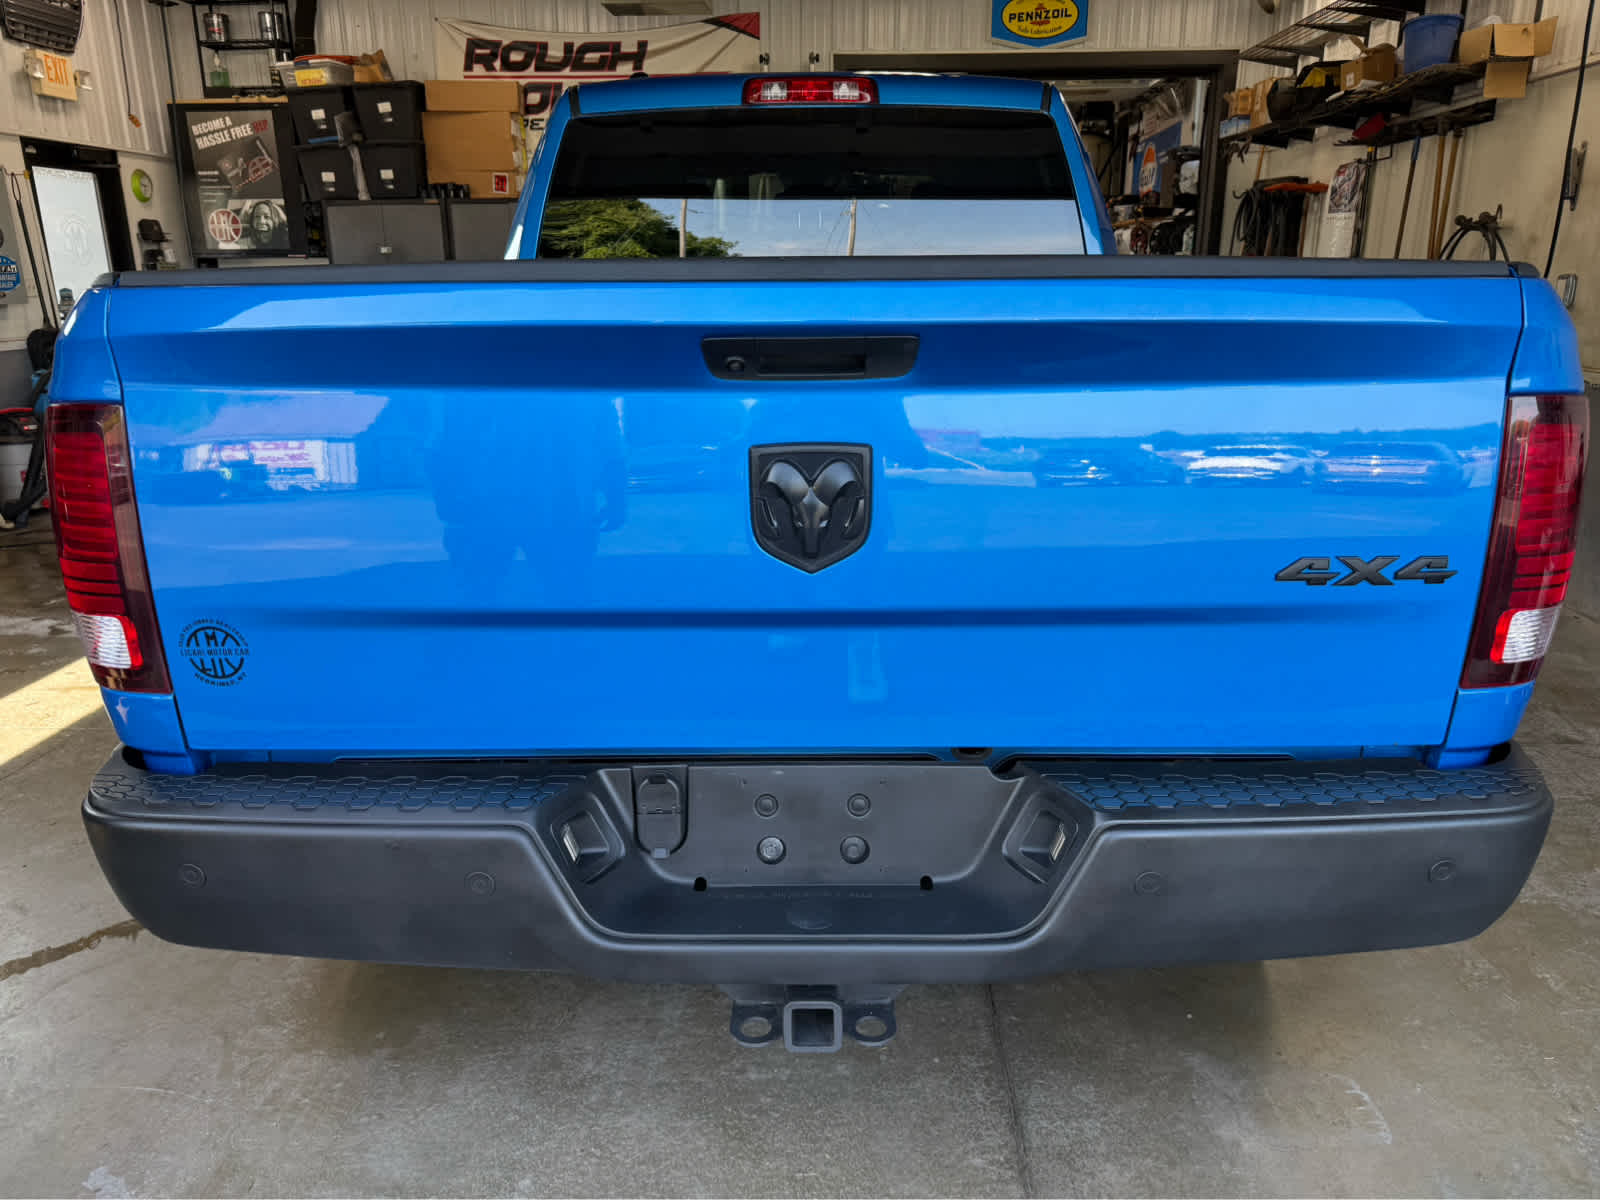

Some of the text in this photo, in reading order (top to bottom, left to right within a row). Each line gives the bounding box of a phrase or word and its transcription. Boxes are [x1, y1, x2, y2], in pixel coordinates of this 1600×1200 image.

[1008, 8, 1073, 24] PENNZOIL
[463, 38, 648, 73] ROUGH
[43, 54, 69, 88] EXIT
[191, 116, 233, 136] BECOME A
[195, 130, 232, 150] HASSLE
[229, 123, 254, 140] FREE
[1275, 555, 1458, 586] 4X4
[207, 647, 233, 657] MOTOR
[234, 647, 250, 657] CAR
